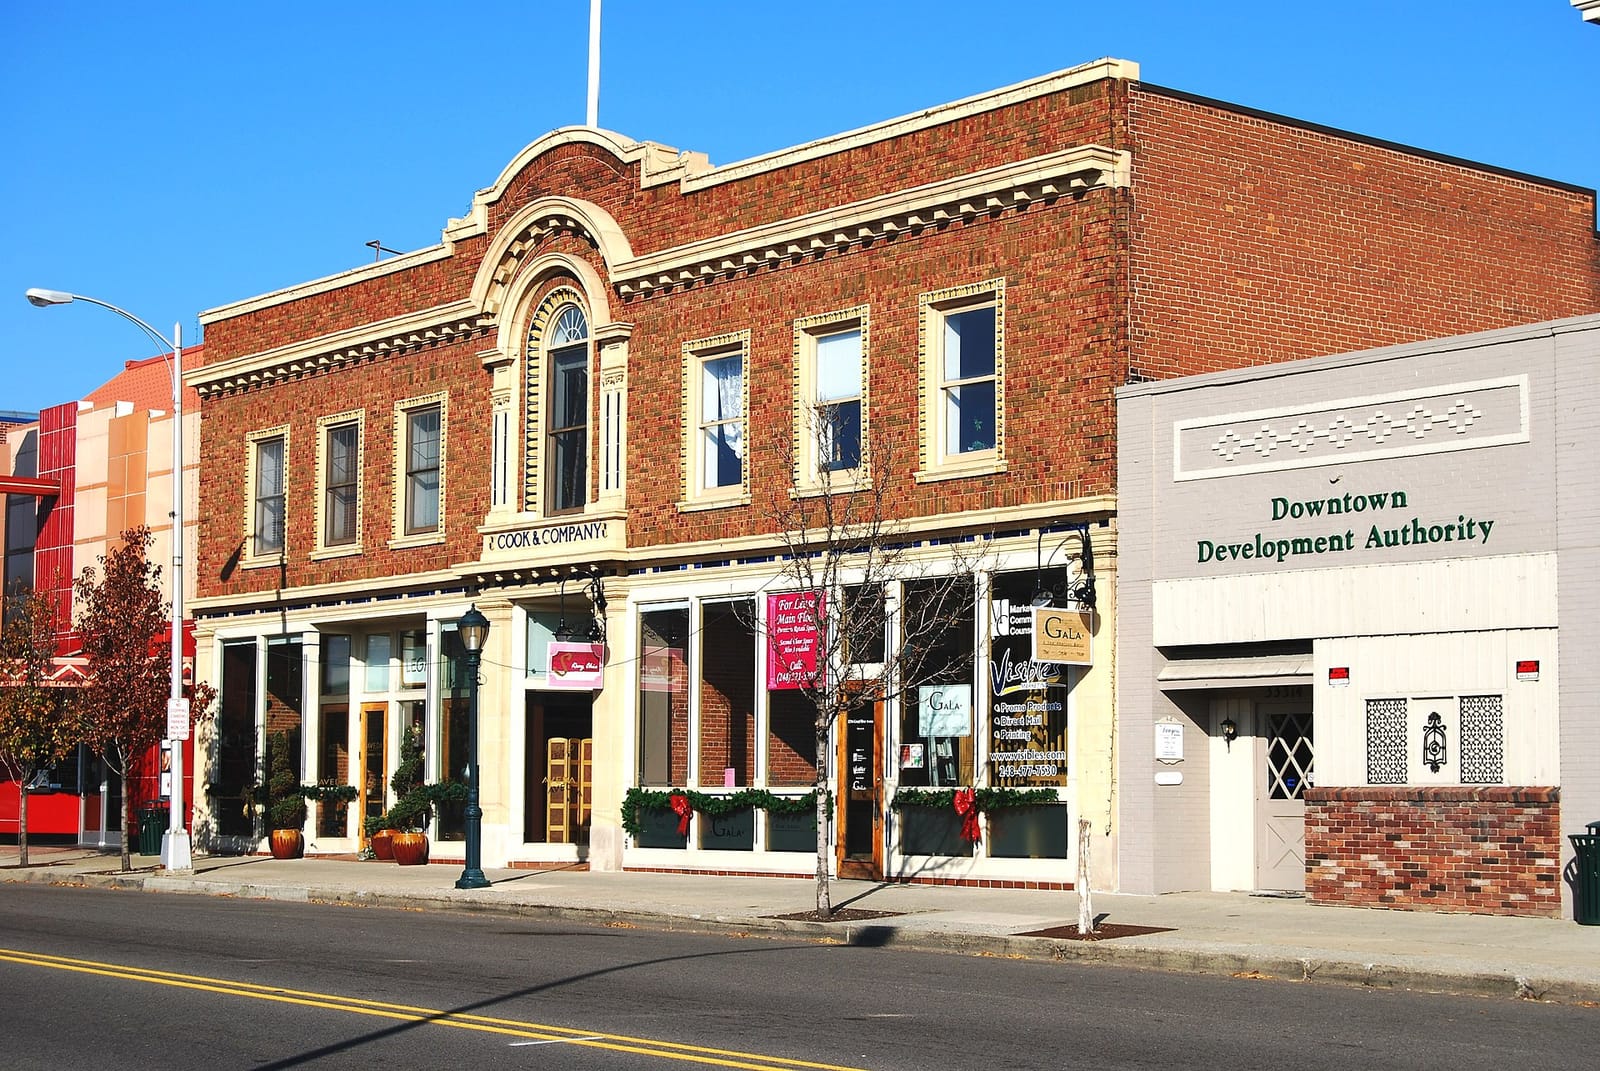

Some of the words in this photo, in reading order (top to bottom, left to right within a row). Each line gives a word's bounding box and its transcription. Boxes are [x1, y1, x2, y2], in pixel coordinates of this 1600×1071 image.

[1271, 490, 1408, 520] Downtown
[498, 530, 530, 549] COOK
[533, 530, 541, 545] &
[542, 523, 600, 545] COMPANY
[1197, 529, 1354, 563] Development
[1365, 515, 1494, 548] Authority
[778, 599, 793, 611] For
[776, 613, 796, 625] Main
[1045, 616, 1082, 640] GALA
[989, 647, 1062, 697] Visibles
[930, 691, 960, 711] GALA
[1001, 703, 1026, 713] Promo
[1027, 701, 1062, 712] Products
[1001, 716, 1024, 726] Direct
[1026, 714, 1043, 725] Mail
[1001, 729, 1031, 741] Printing
[990, 749, 1066, 763] www.visibles.com
